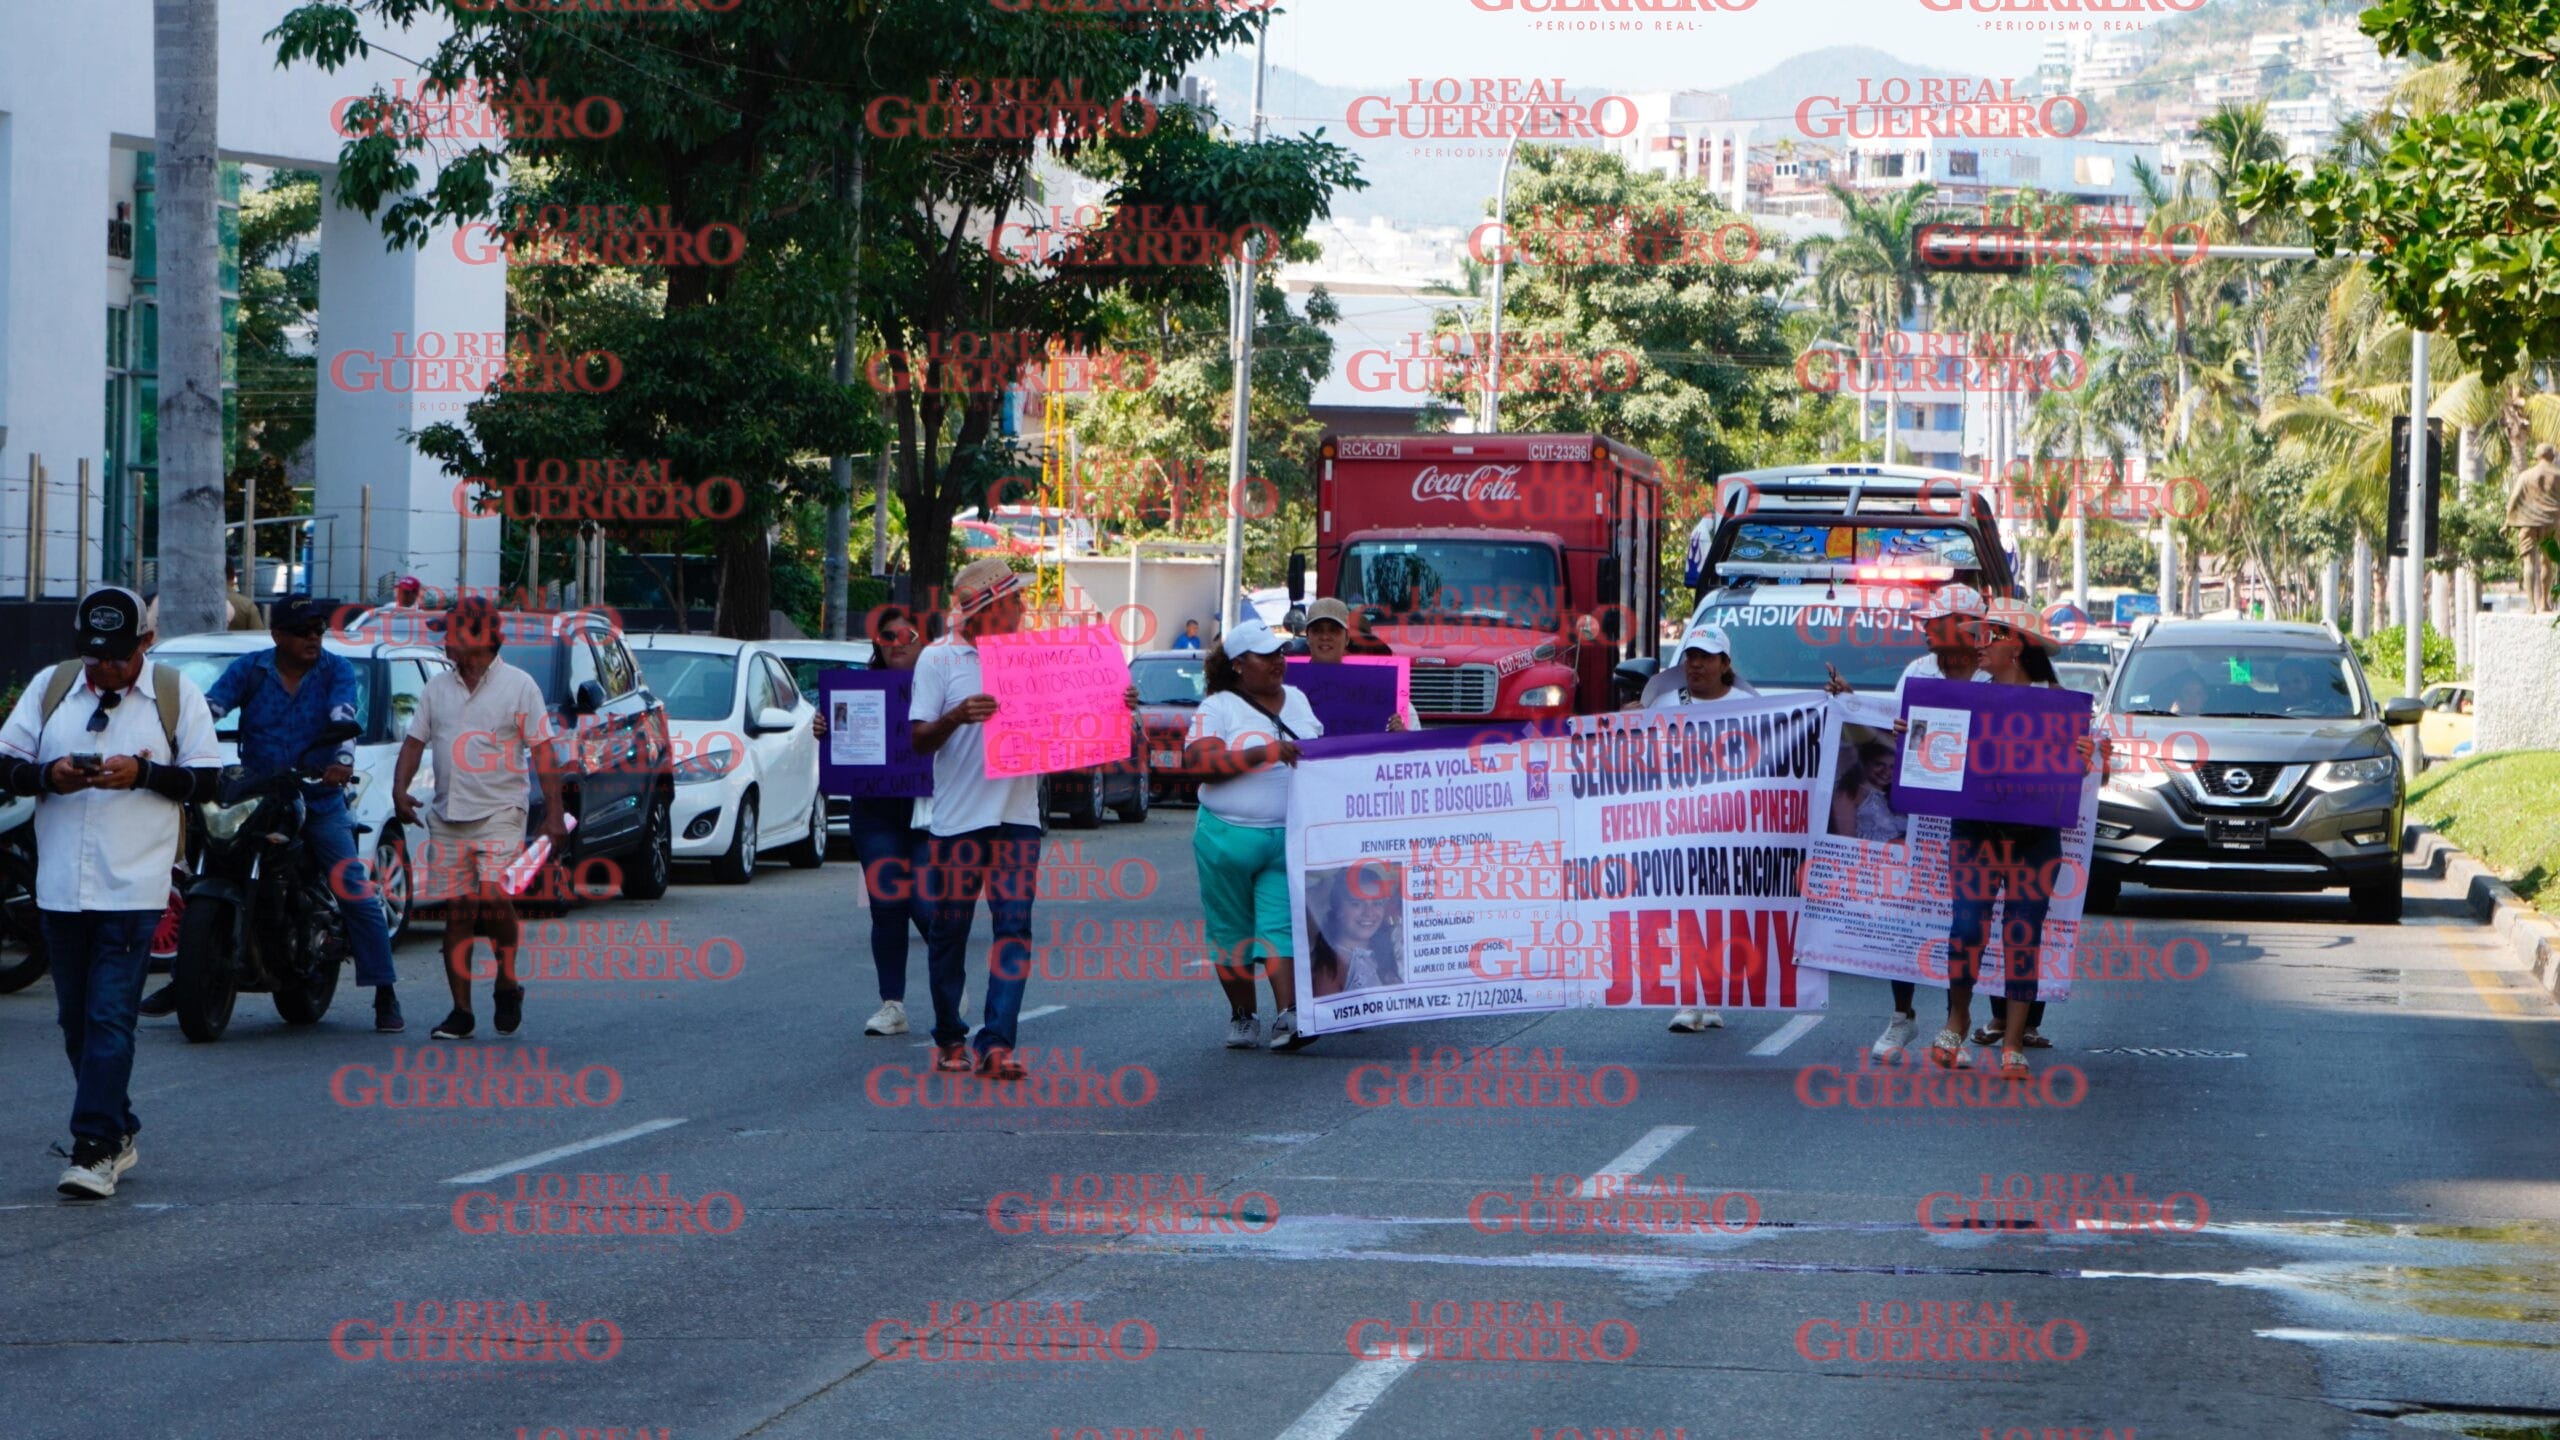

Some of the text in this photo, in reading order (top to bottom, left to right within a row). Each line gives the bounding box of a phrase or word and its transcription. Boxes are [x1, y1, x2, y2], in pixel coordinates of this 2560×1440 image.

[1341, 442, 1398, 456] RCK-071
[1531, 444, 1587, 460] CUT-23296
[1570, 716, 1661, 799] SEÑORA
[1667, 706, 1828, 789] GOBERNADOR
[1375, 757, 1498, 782] ALERTA VIOLETA
[1346, 778, 1513, 818] BOLETÍN DE BÚSQUEDA
[1601, 789, 1809, 843] EVELYN SALGADO PINEDA
[1360, 840, 1406, 853] JENNIFER
[1563, 857, 1600, 901] PIDO
[1605, 853, 1626, 898] SU
[1631, 847, 1685, 898] APOYO
[1687, 847, 1731, 898] PARA
[1413, 917, 1475, 928] NACIONALIDAD:
[1414, 947, 1440, 958] LUGAR
[1442, 946, 1453, 955] DE
[1454, 945, 1469, 955] LOS
[1605, 909, 1798, 1008] JENNY
[1447, 963, 1457, 972] DE
[1333, 988, 1527, 1020] VISTA POR ÚLTIMA VEZ: 27/12/2024.
